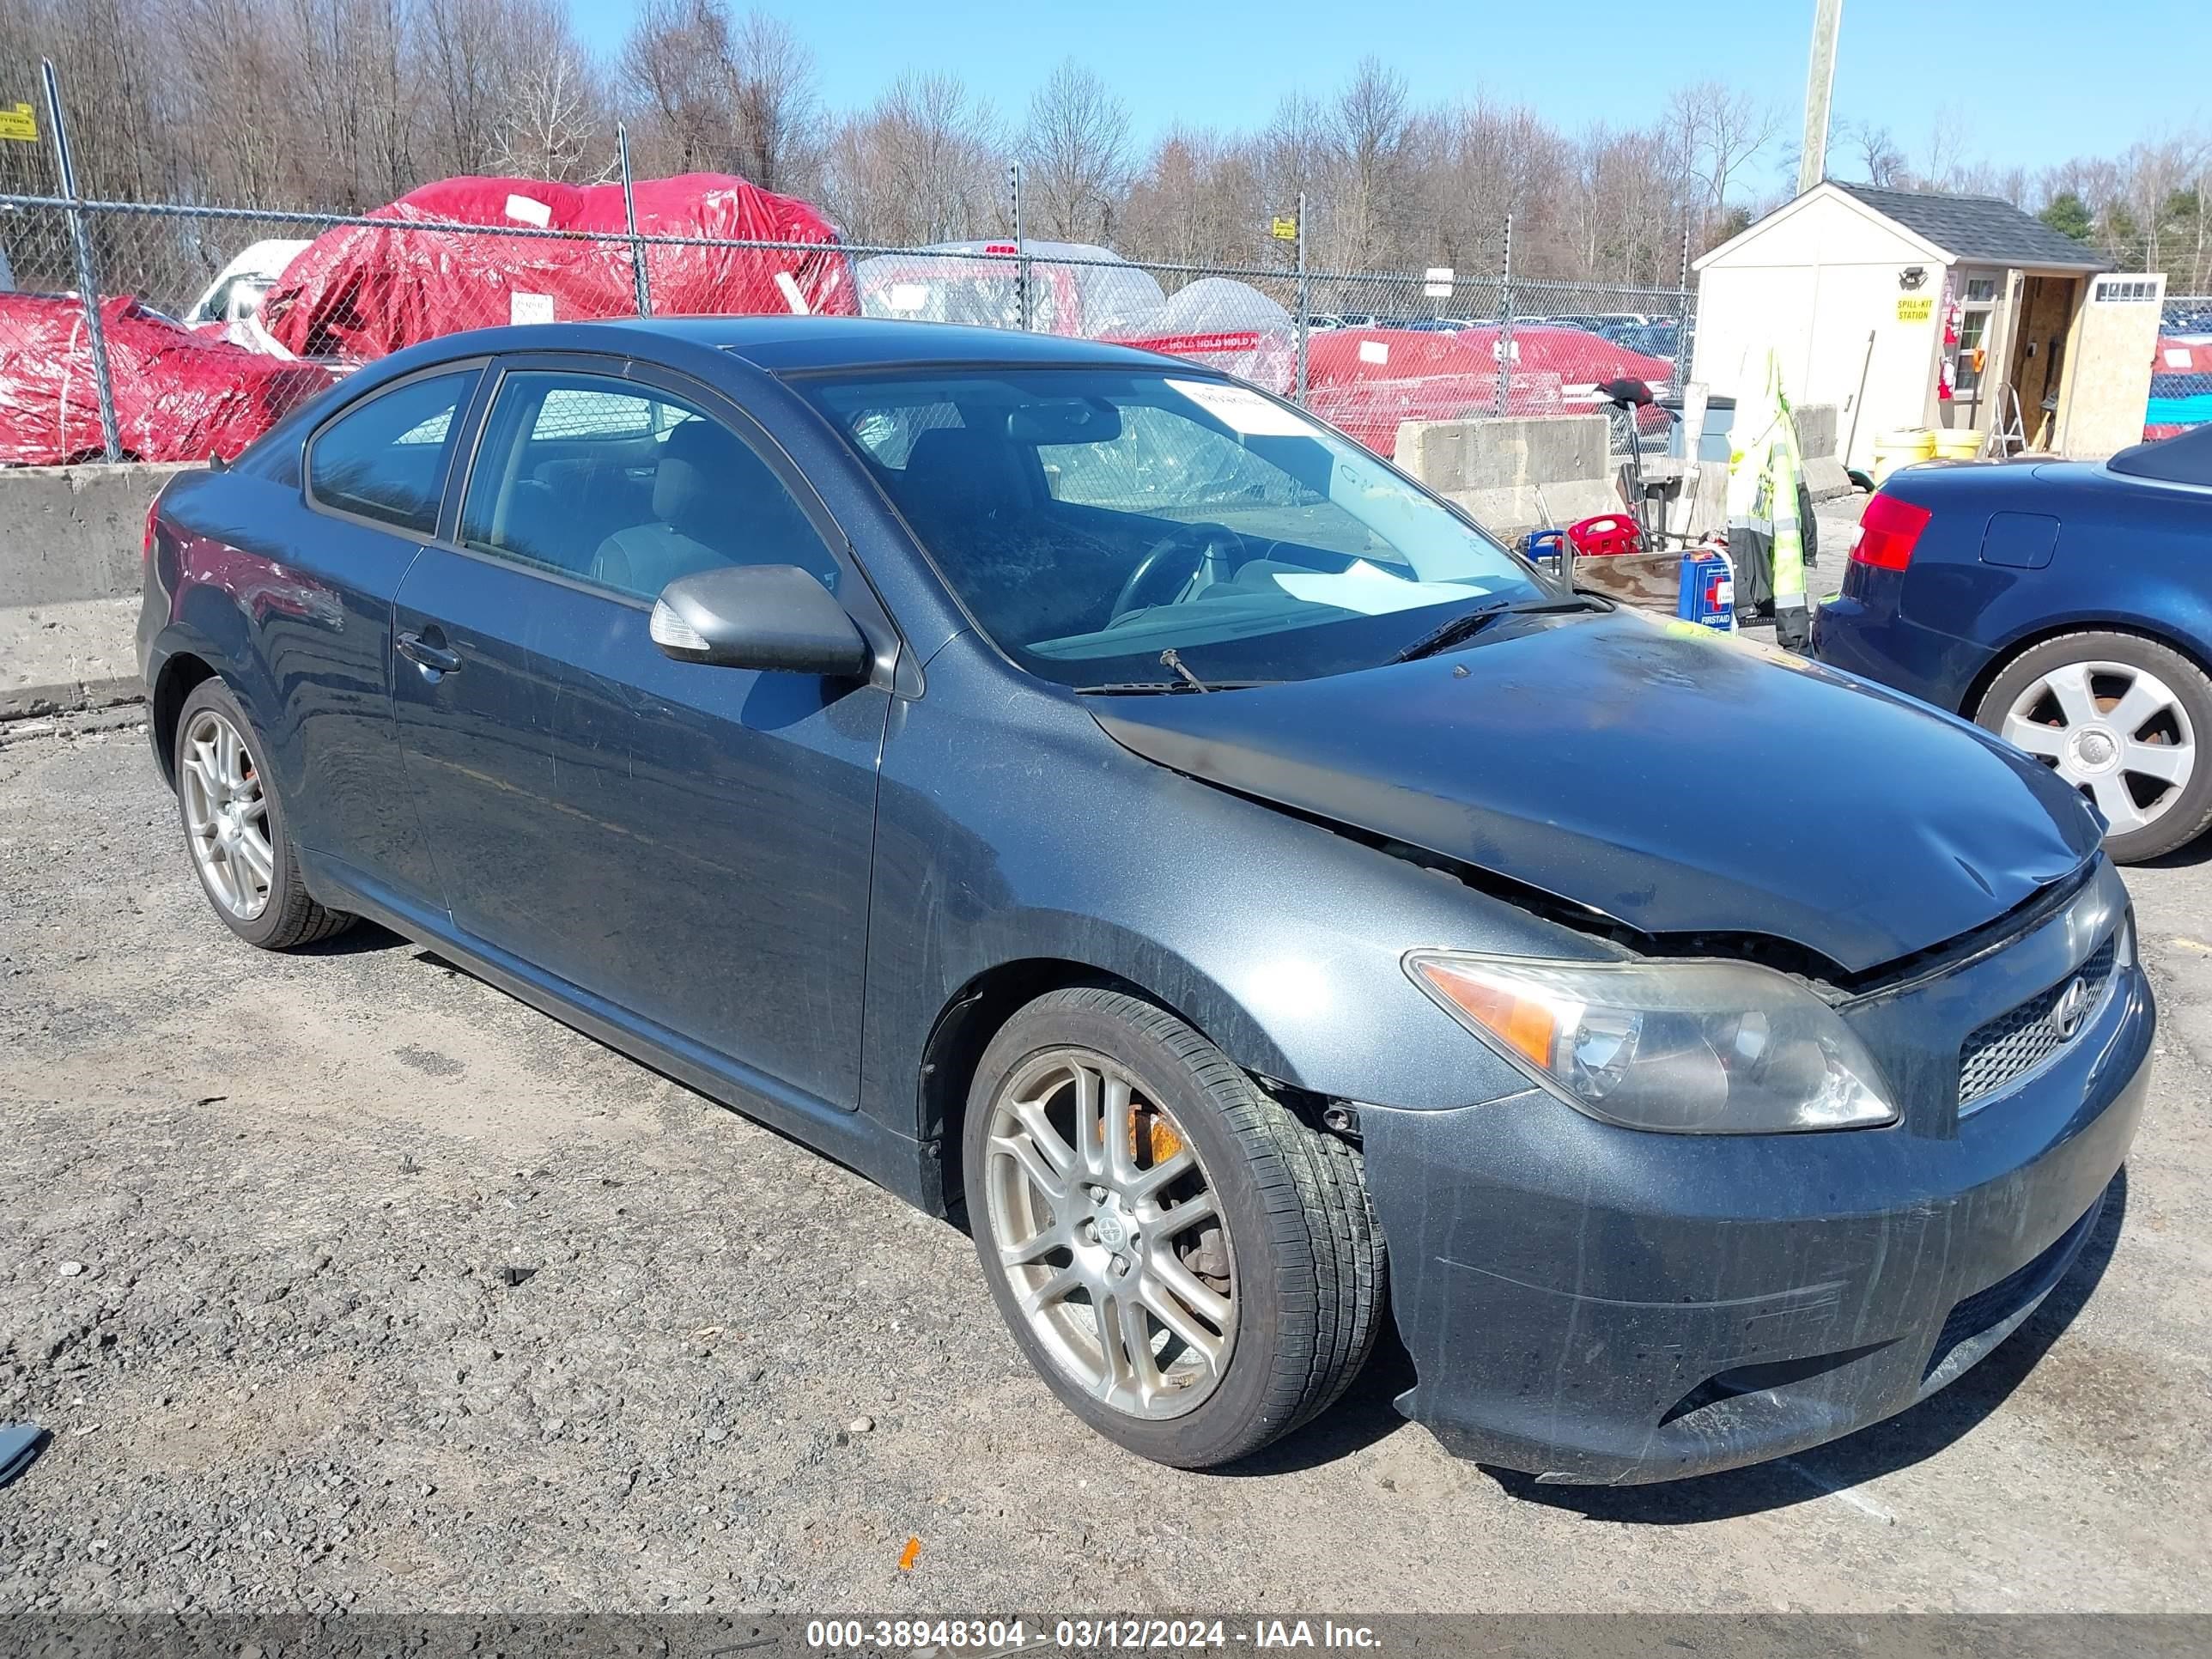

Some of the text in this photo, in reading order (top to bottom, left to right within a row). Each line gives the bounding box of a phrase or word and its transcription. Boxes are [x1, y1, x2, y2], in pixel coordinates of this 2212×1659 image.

[1898, 300, 1933, 309] SPILL-KIT
[1899, 311, 1929, 319] STATION
[1169, 341, 1194, 349] HOLD
[1196, 339, 1222, 348] HOLD
[1224, 337, 1249, 346] HOLD
